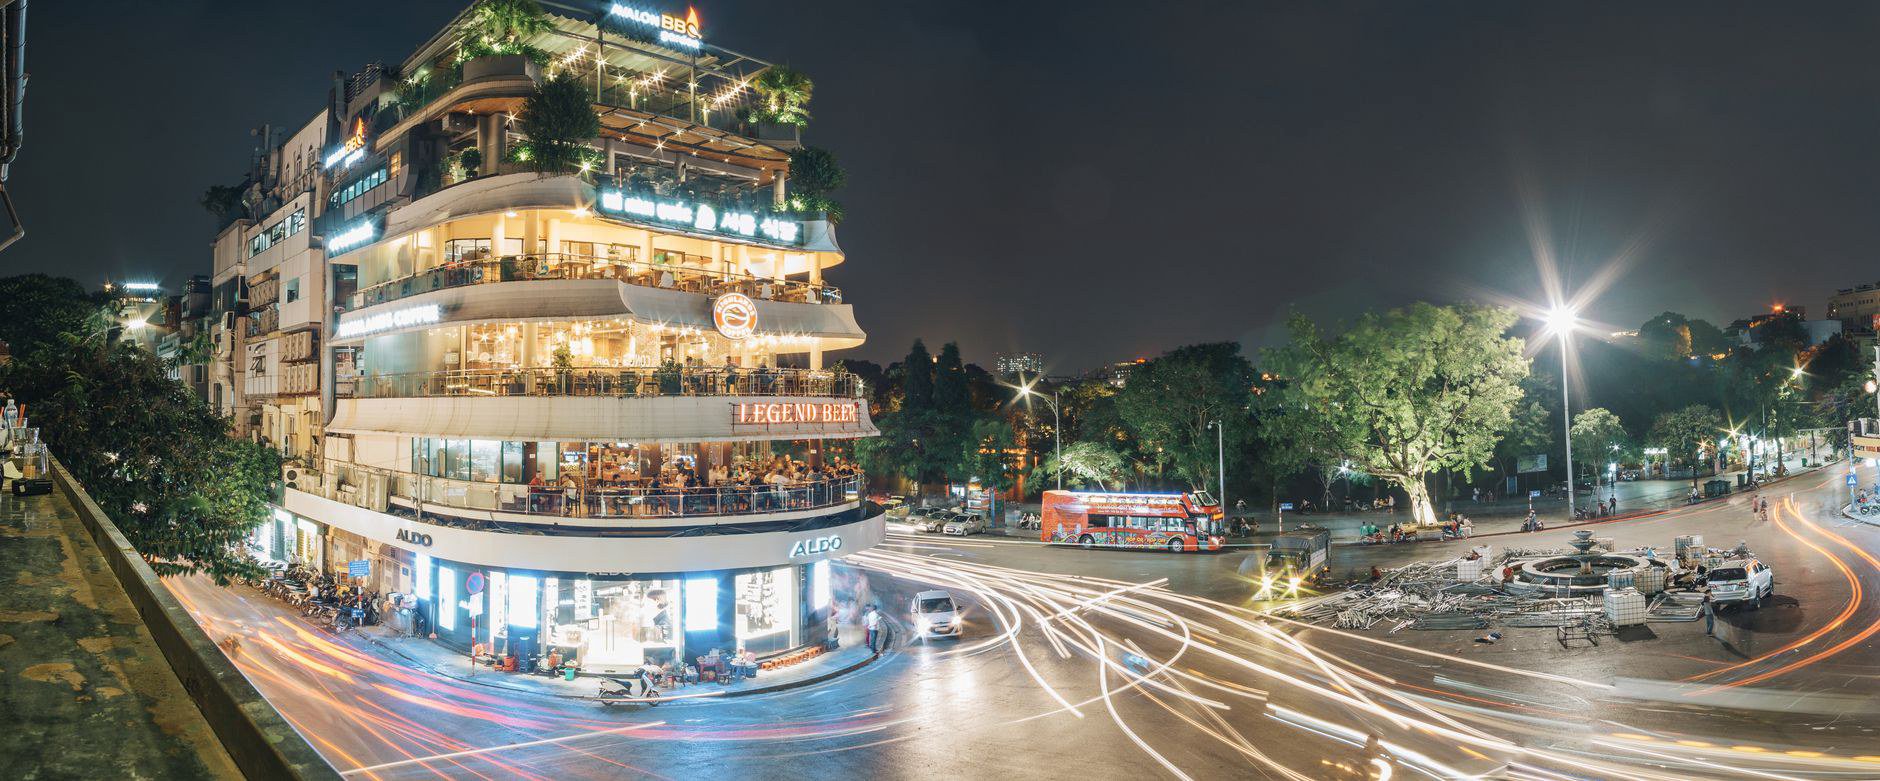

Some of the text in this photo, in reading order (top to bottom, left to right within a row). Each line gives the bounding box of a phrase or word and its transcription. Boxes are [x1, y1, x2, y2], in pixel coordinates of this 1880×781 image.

[611, 3, 702, 40] AVALON BBQ
[740, 402, 857, 423] LEGEND BEER
[395, 528, 433, 546] ALDO
[790, 535, 842, 557] ALDO
